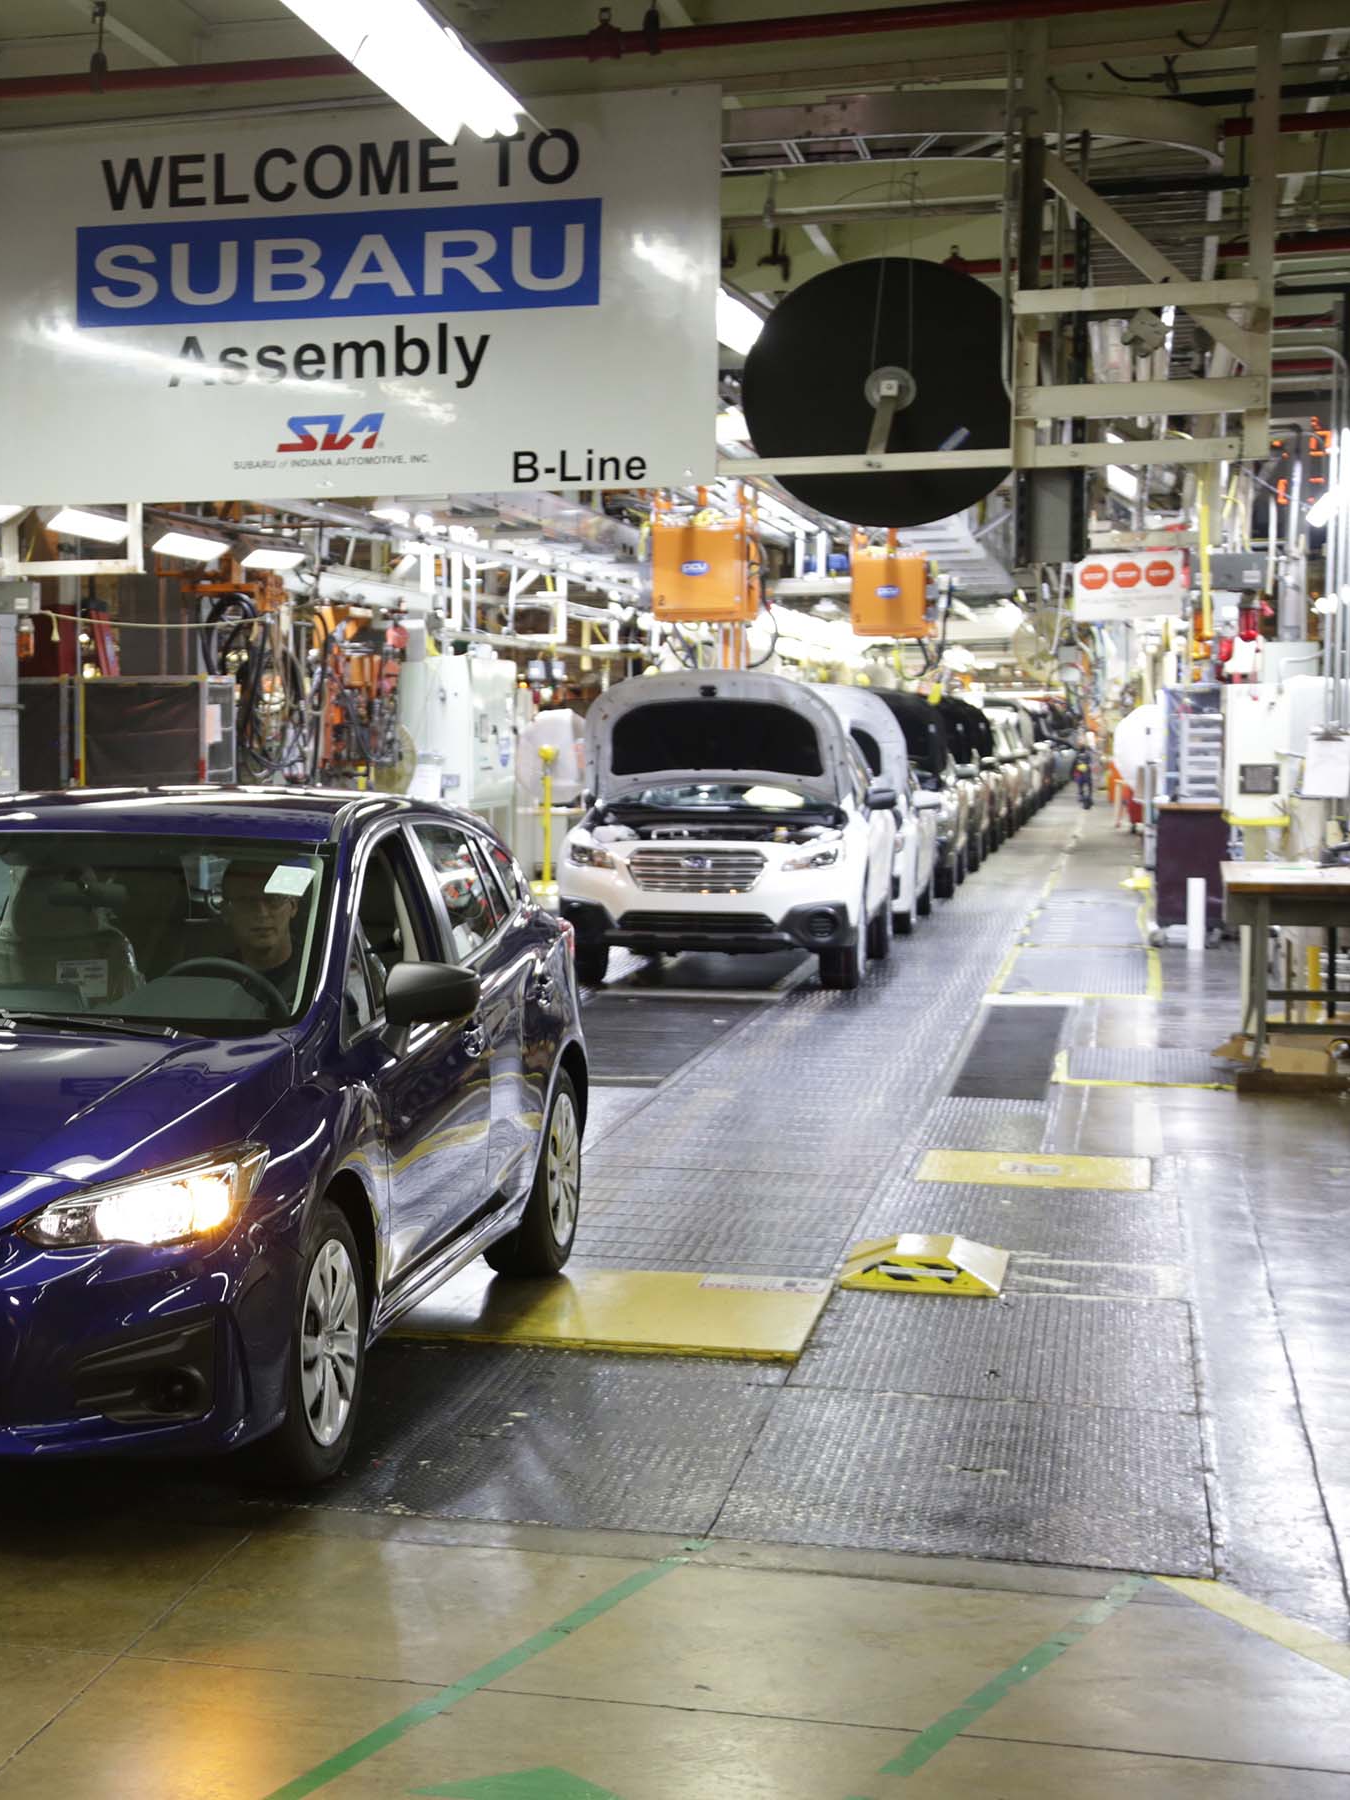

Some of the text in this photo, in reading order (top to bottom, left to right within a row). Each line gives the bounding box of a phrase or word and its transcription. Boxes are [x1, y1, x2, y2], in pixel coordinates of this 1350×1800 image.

[101, 128, 580, 211] WELCOME TO
[91, 223, 585, 309] SUBARU
[168, 322, 491, 389] Assembly
[233, 460, 275, 470] SUBARU
[291, 458, 332, 468] INDIANA
[336, 455, 408, 467] AUTOMOTIVE,
[410, 454, 431, 464] INC.
[512, 448, 648, 485] B-Line
